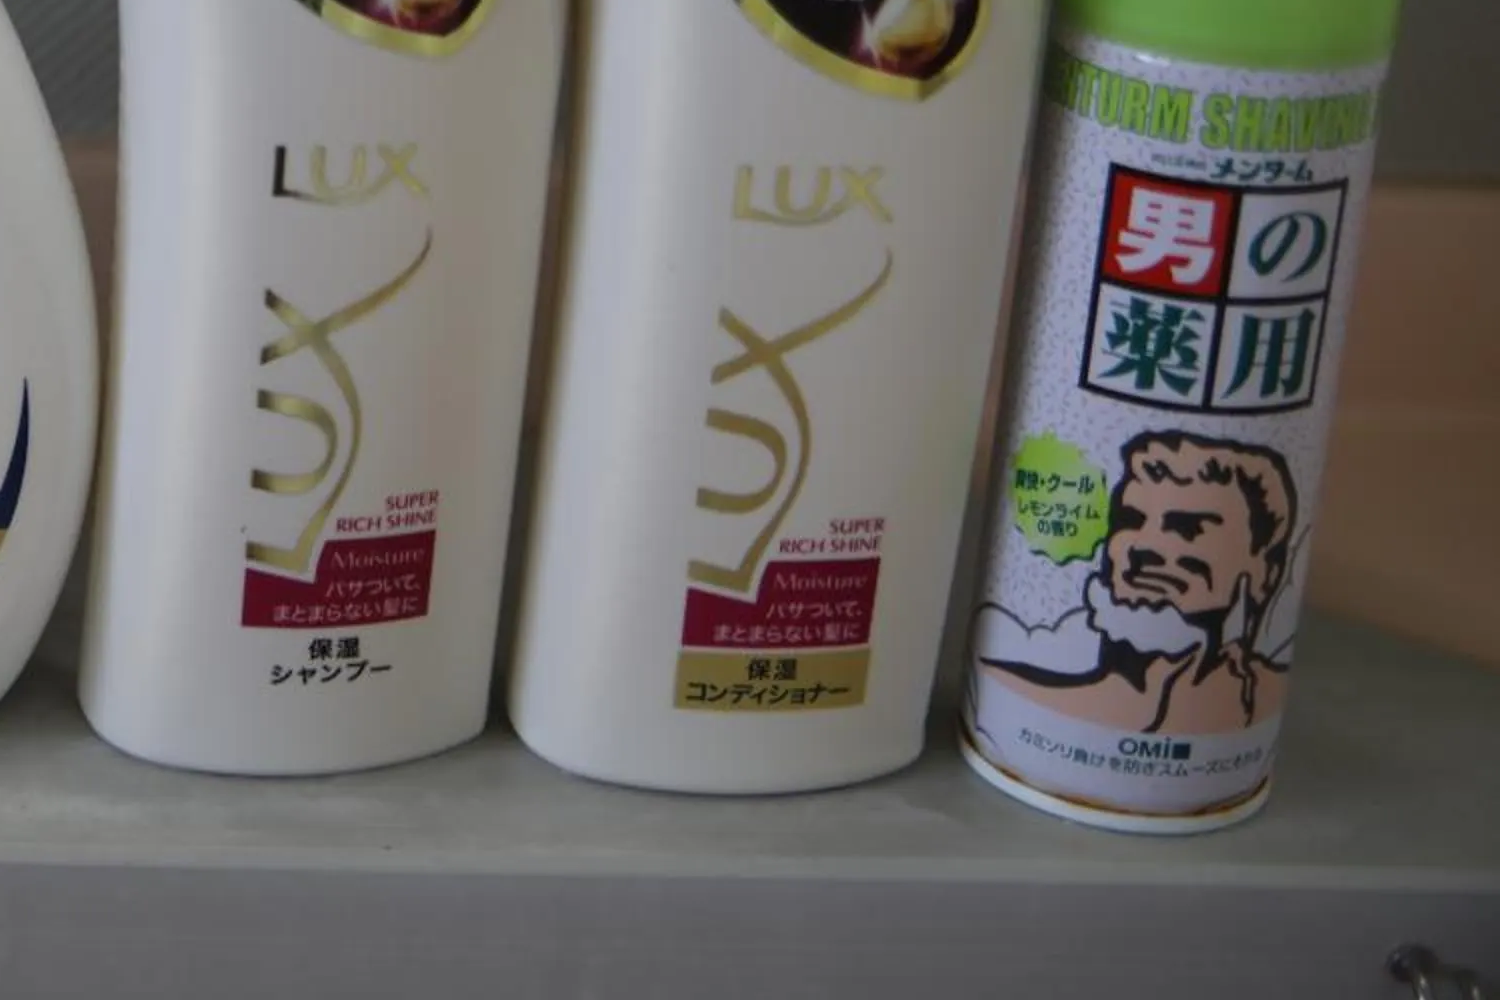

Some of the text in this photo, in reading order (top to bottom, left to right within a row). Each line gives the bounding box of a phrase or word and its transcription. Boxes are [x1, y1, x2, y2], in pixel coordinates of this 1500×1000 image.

[271, 143, 431, 207] LUX
[731, 163, 895, 228] LUX
[385, 489, 439, 512] SUPER
[336, 508, 437, 534] RICH SHINE
[829, 516, 885, 535] SUPER
[779, 534, 882, 554] RICH SHINE
[773, 571, 869, 591] Moisture
